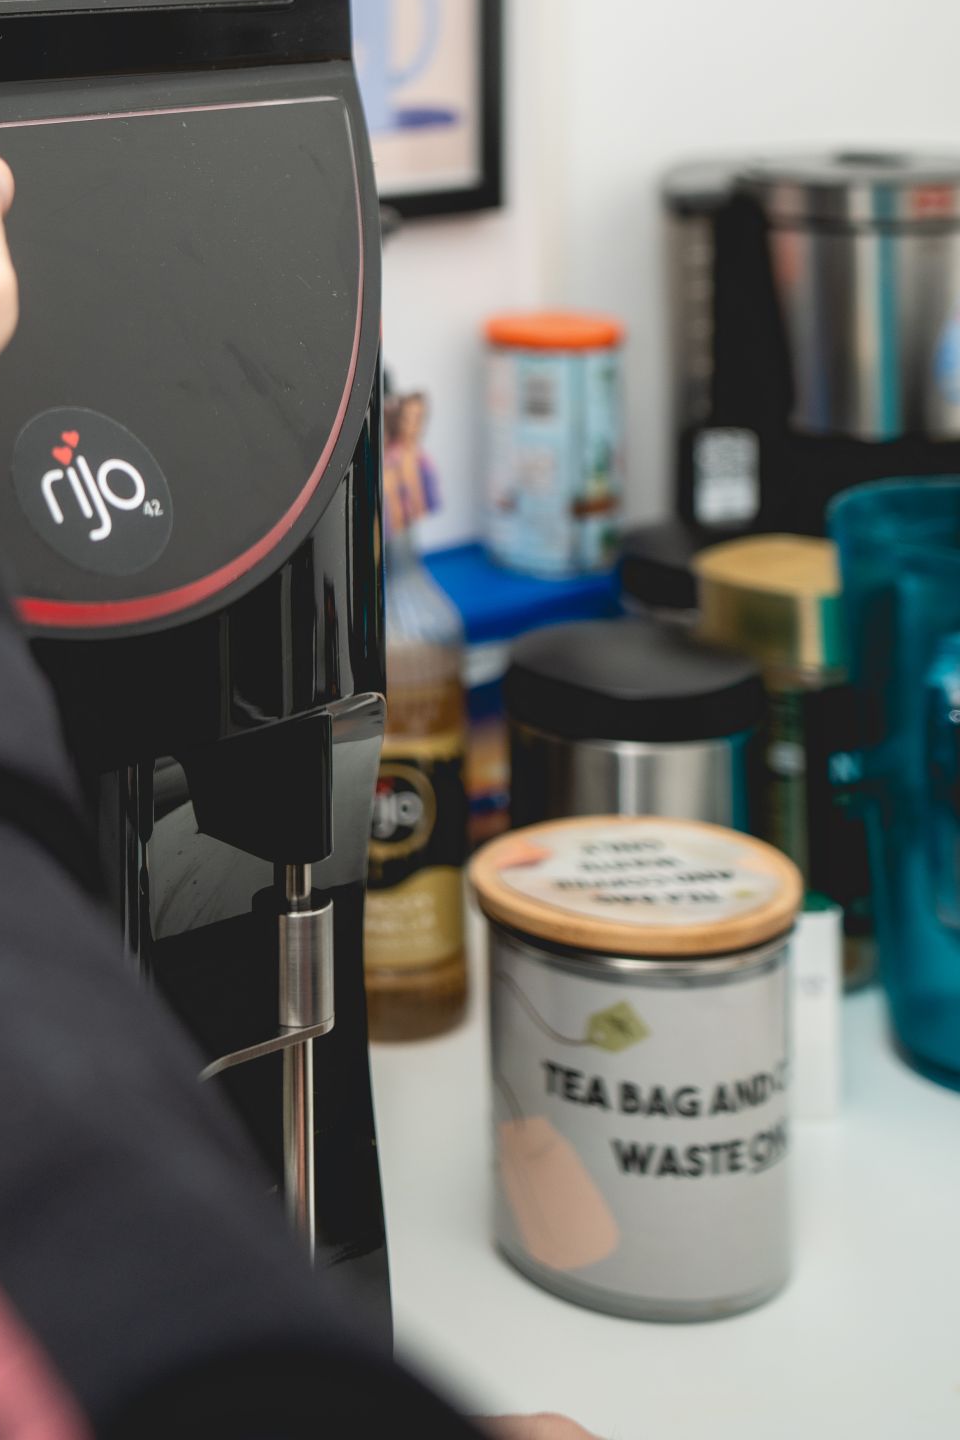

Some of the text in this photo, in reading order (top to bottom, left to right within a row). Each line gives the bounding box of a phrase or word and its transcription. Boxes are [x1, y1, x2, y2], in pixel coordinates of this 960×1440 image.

[41, 455, 163, 541] rijo 42
[541, 1059, 612, 1110] TEA
[617, 1080, 702, 1118] BAG
[709, 1074, 775, 1116] AND
[610, 1136, 744, 1178] WASTE
